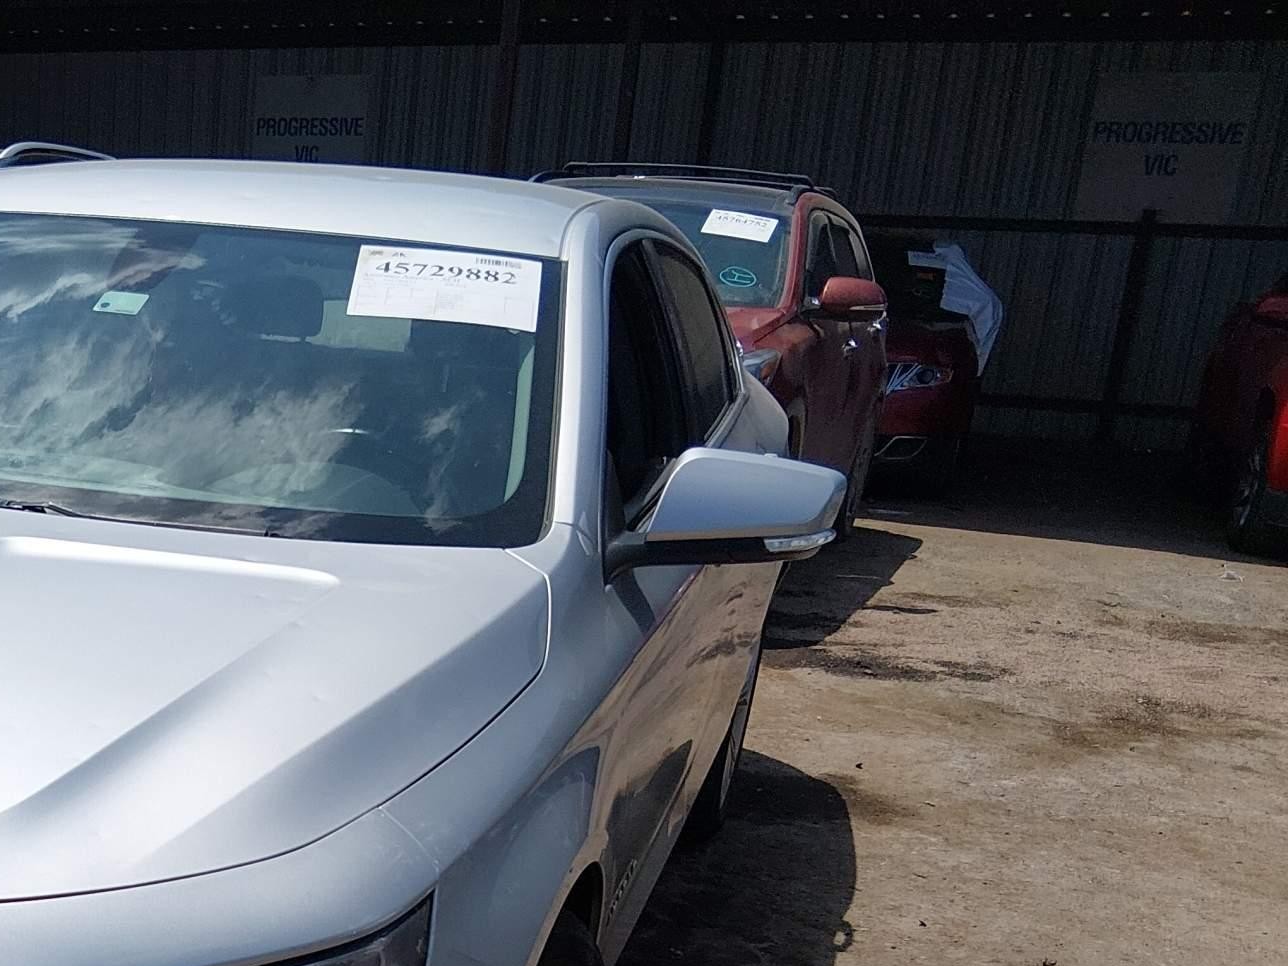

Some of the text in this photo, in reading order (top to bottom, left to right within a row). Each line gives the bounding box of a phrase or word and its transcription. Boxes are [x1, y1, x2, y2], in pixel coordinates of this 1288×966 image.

[256, 117, 364, 137] PROGRESSIVE
[1094, 121, 1244, 145] PROGRESSIVE
[294, 145, 320, 163] VIC
[1144, 154, 1178, 177] VIC
[375, 261, 518, 285] 45729882
